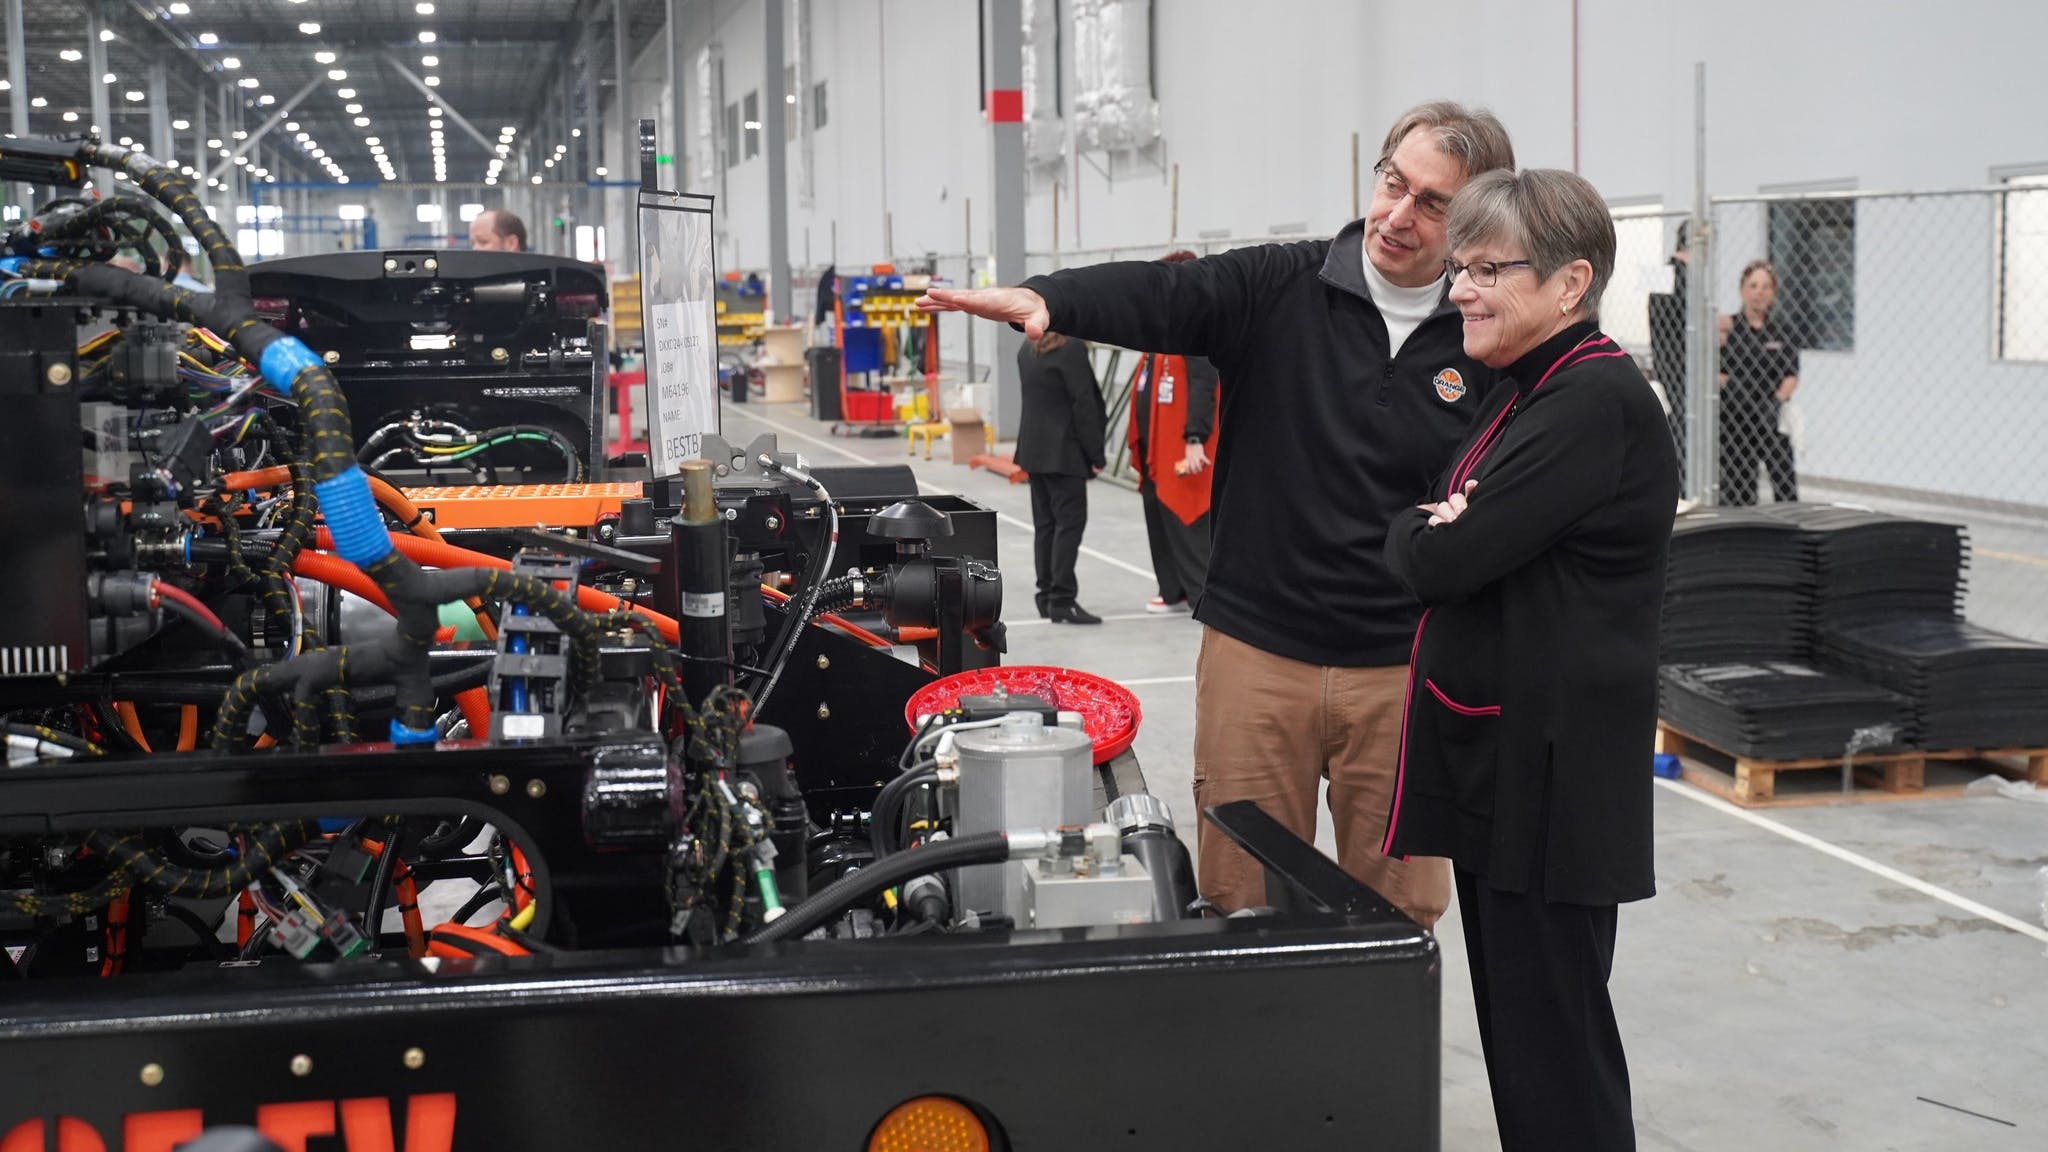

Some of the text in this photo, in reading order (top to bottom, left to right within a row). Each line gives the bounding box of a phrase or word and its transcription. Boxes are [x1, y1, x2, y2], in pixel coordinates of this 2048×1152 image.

[661, 382, 689, 400] M64196
[1434, 377, 1465, 393] ORANGE
[666, 432, 703, 460] BESTB
